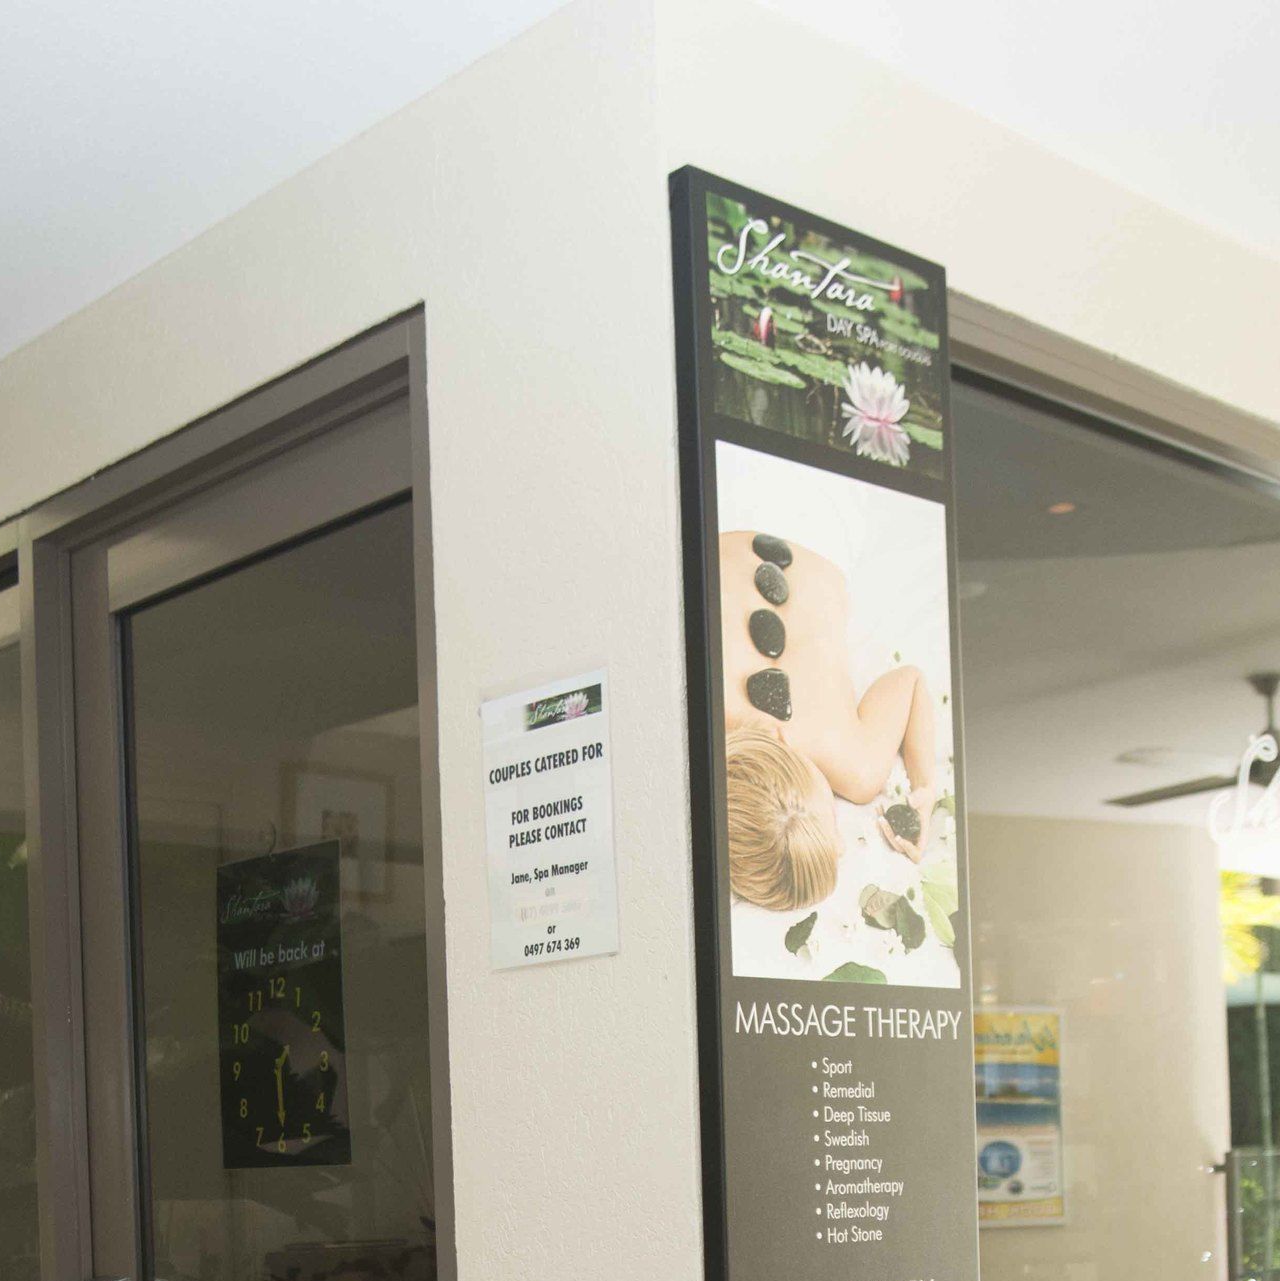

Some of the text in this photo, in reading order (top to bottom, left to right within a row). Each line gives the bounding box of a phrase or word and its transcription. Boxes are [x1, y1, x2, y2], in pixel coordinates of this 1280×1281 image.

[827, 313, 878, 347] DAY SPA
[489, 742, 603, 784] COUPLES CATERED FOR
[512, 796, 583, 825] FOR BOOKINGS
[509, 818, 587, 848] PLEASE CONTACT
[511, 861, 588, 884] Jane, Spa Manager
[547, 925, 556, 934] or
[234, 940, 325, 970] Will be back at
[524, 937, 580, 956] 0497 674 369
[269, 977, 286, 998] 12
[295, 987, 301, 1007] 1
[248, 991, 263, 1011] 11
[312, 1011, 321, 1032] 2
[735, 1001, 856, 1037] MASSAGE
[863, 1006, 962, 1040] THERAPY
[233, 1024, 249, 1044] 10
[233, 1061, 241, 1081] 9
[320, 1051, 328, 1071] 3
[822, 1057, 852, 1078] Sport
[823, 1082, 875, 1099] Remedial
[240, 1098, 248, 1118] 8
[315, 1092, 325, 1112] 4
[824, 1106, 891, 1126] Deep Tissue
[256, 1127, 264, 1147] 7
[278, 1132, 287, 1153] 6
[302, 1123, 311, 1143] 5
[824, 1130, 870, 1147] Swedish
[825, 1154, 883, 1175] Pregnancy
[825, 1177, 904, 1197] Aromatherapy
[827, 1201, 890, 1221] Reflexology
[827, 1226, 883, 1244] Hot Stone
